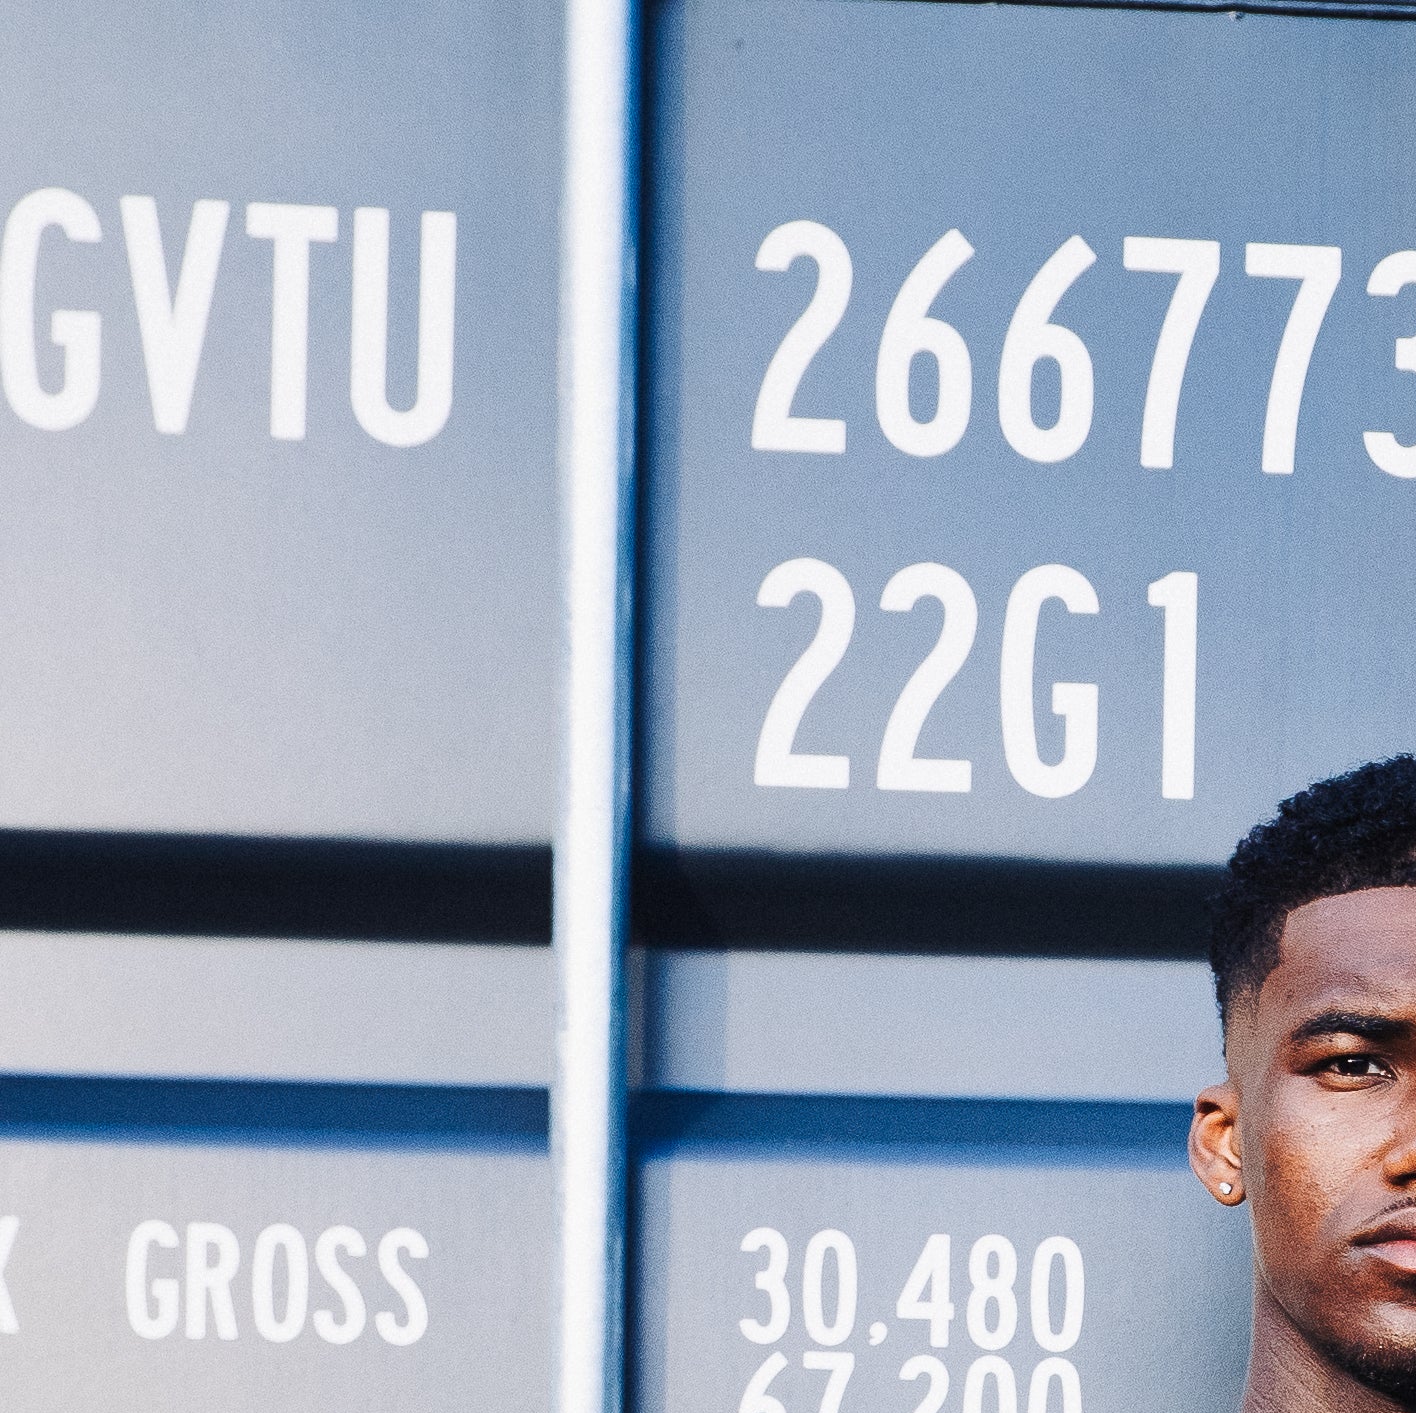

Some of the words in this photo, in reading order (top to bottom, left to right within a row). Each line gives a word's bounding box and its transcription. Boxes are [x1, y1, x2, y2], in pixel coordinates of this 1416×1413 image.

[0, 187, 457, 448] GVTU
[754, 557, 1199, 801] 22G1
[125, 1219, 430, 1347] GROSS
